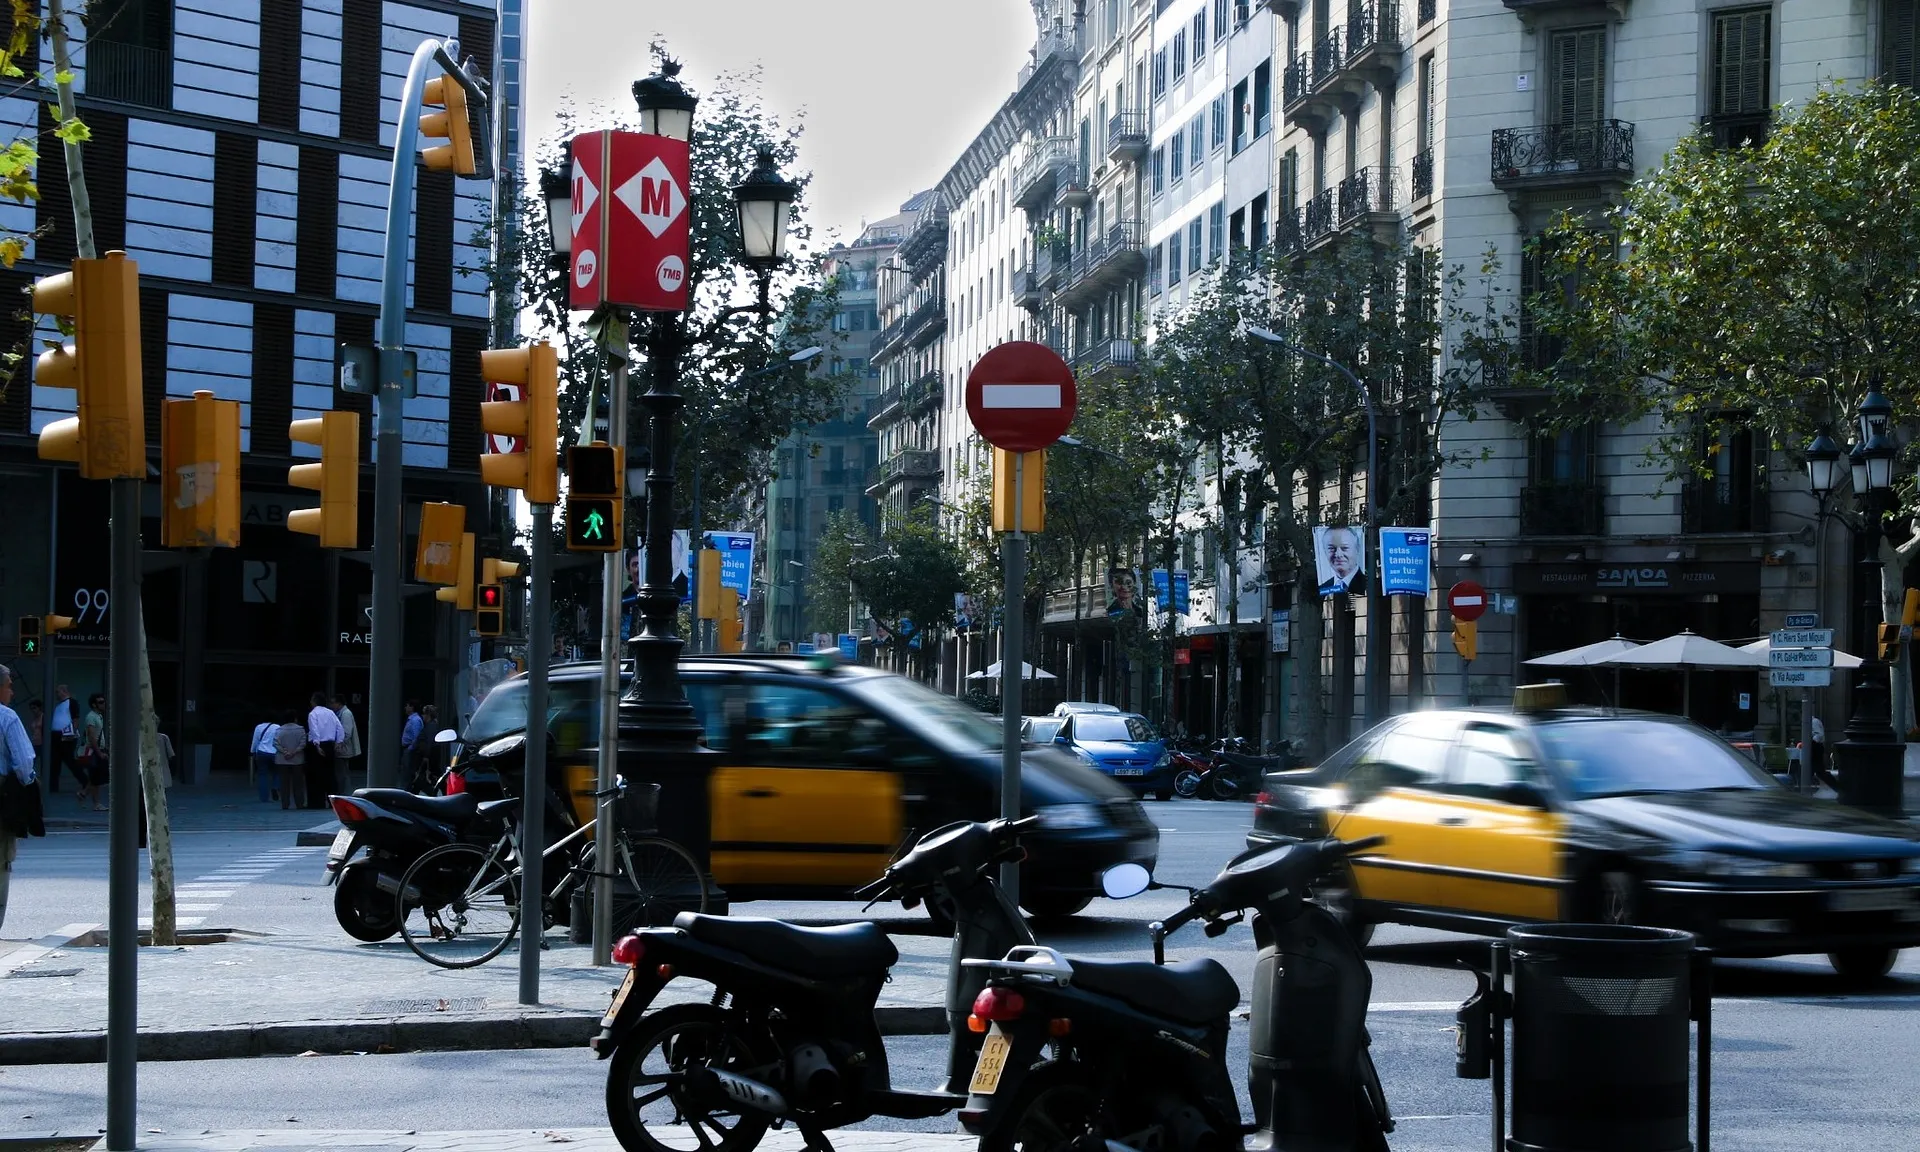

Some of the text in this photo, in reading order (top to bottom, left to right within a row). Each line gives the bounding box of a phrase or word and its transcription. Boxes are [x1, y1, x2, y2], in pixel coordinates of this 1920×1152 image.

[641, 176, 671, 218] M
[578, 263, 593, 276] TMB
[663, 267, 682, 281] TMB
[1389, 547, 1411, 555] estas
[1389, 556, 1424, 565] también
[1403, 566, 1416, 575] tus
[1542, 568, 1716, 587] RESTAURANT SAMOA PIZZERIA
[74, 588, 109, 624] 99
[57, 632, 86, 642] Passeig
[1777, 672, 1805, 684] Via Augusta
